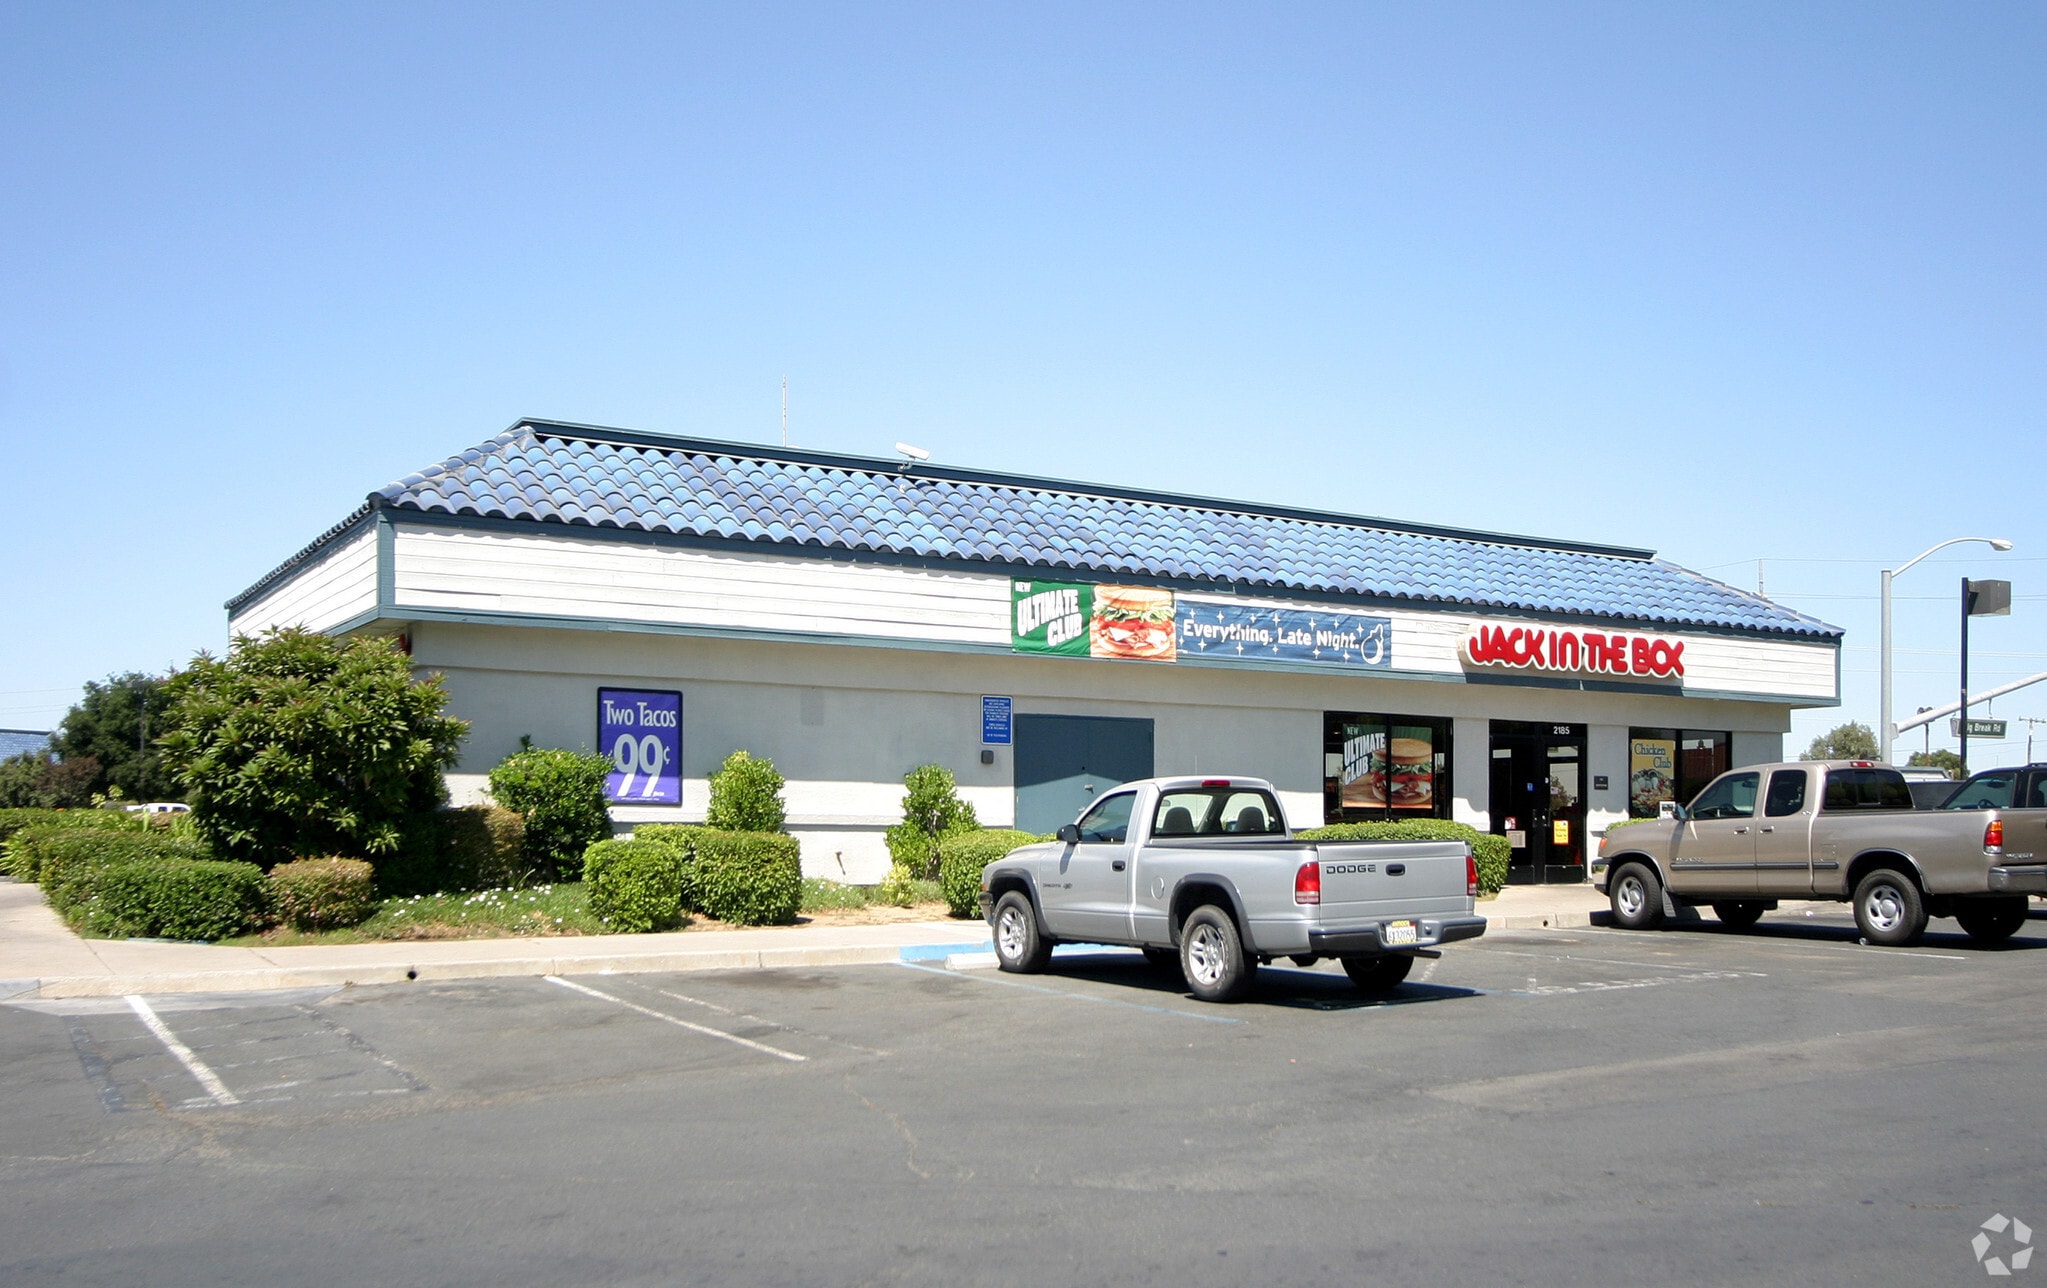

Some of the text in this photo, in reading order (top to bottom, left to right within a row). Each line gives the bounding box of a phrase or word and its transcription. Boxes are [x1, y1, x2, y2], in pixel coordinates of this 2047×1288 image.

[1014, 581, 1032, 593] NEW
[1017, 588, 1080, 637] ULTIMATE
[1047, 612, 1083, 647] CLUB
[1182, 618, 1360, 651] Everything. Late Night.
[1469, 625, 1545, 667] JACK
[1582, 632, 1628, 673] THE
[1631, 637, 1685, 676] BOX
[603, 700, 677, 728] Two Tacos
[1347, 727, 1359, 736] NEW
[1553, 726, 1570, 735] 2185
[1974, 723, 1992, 732] Break
[1344, 732, 1386, 767] ULTIMATE
[1634, 743, 1666, 755] Chicken
[1345, 755, 1369, 786] CLUB
[1653, 757, 1672, 768] Club
[1326, 864, 1377, 875] DODGE
